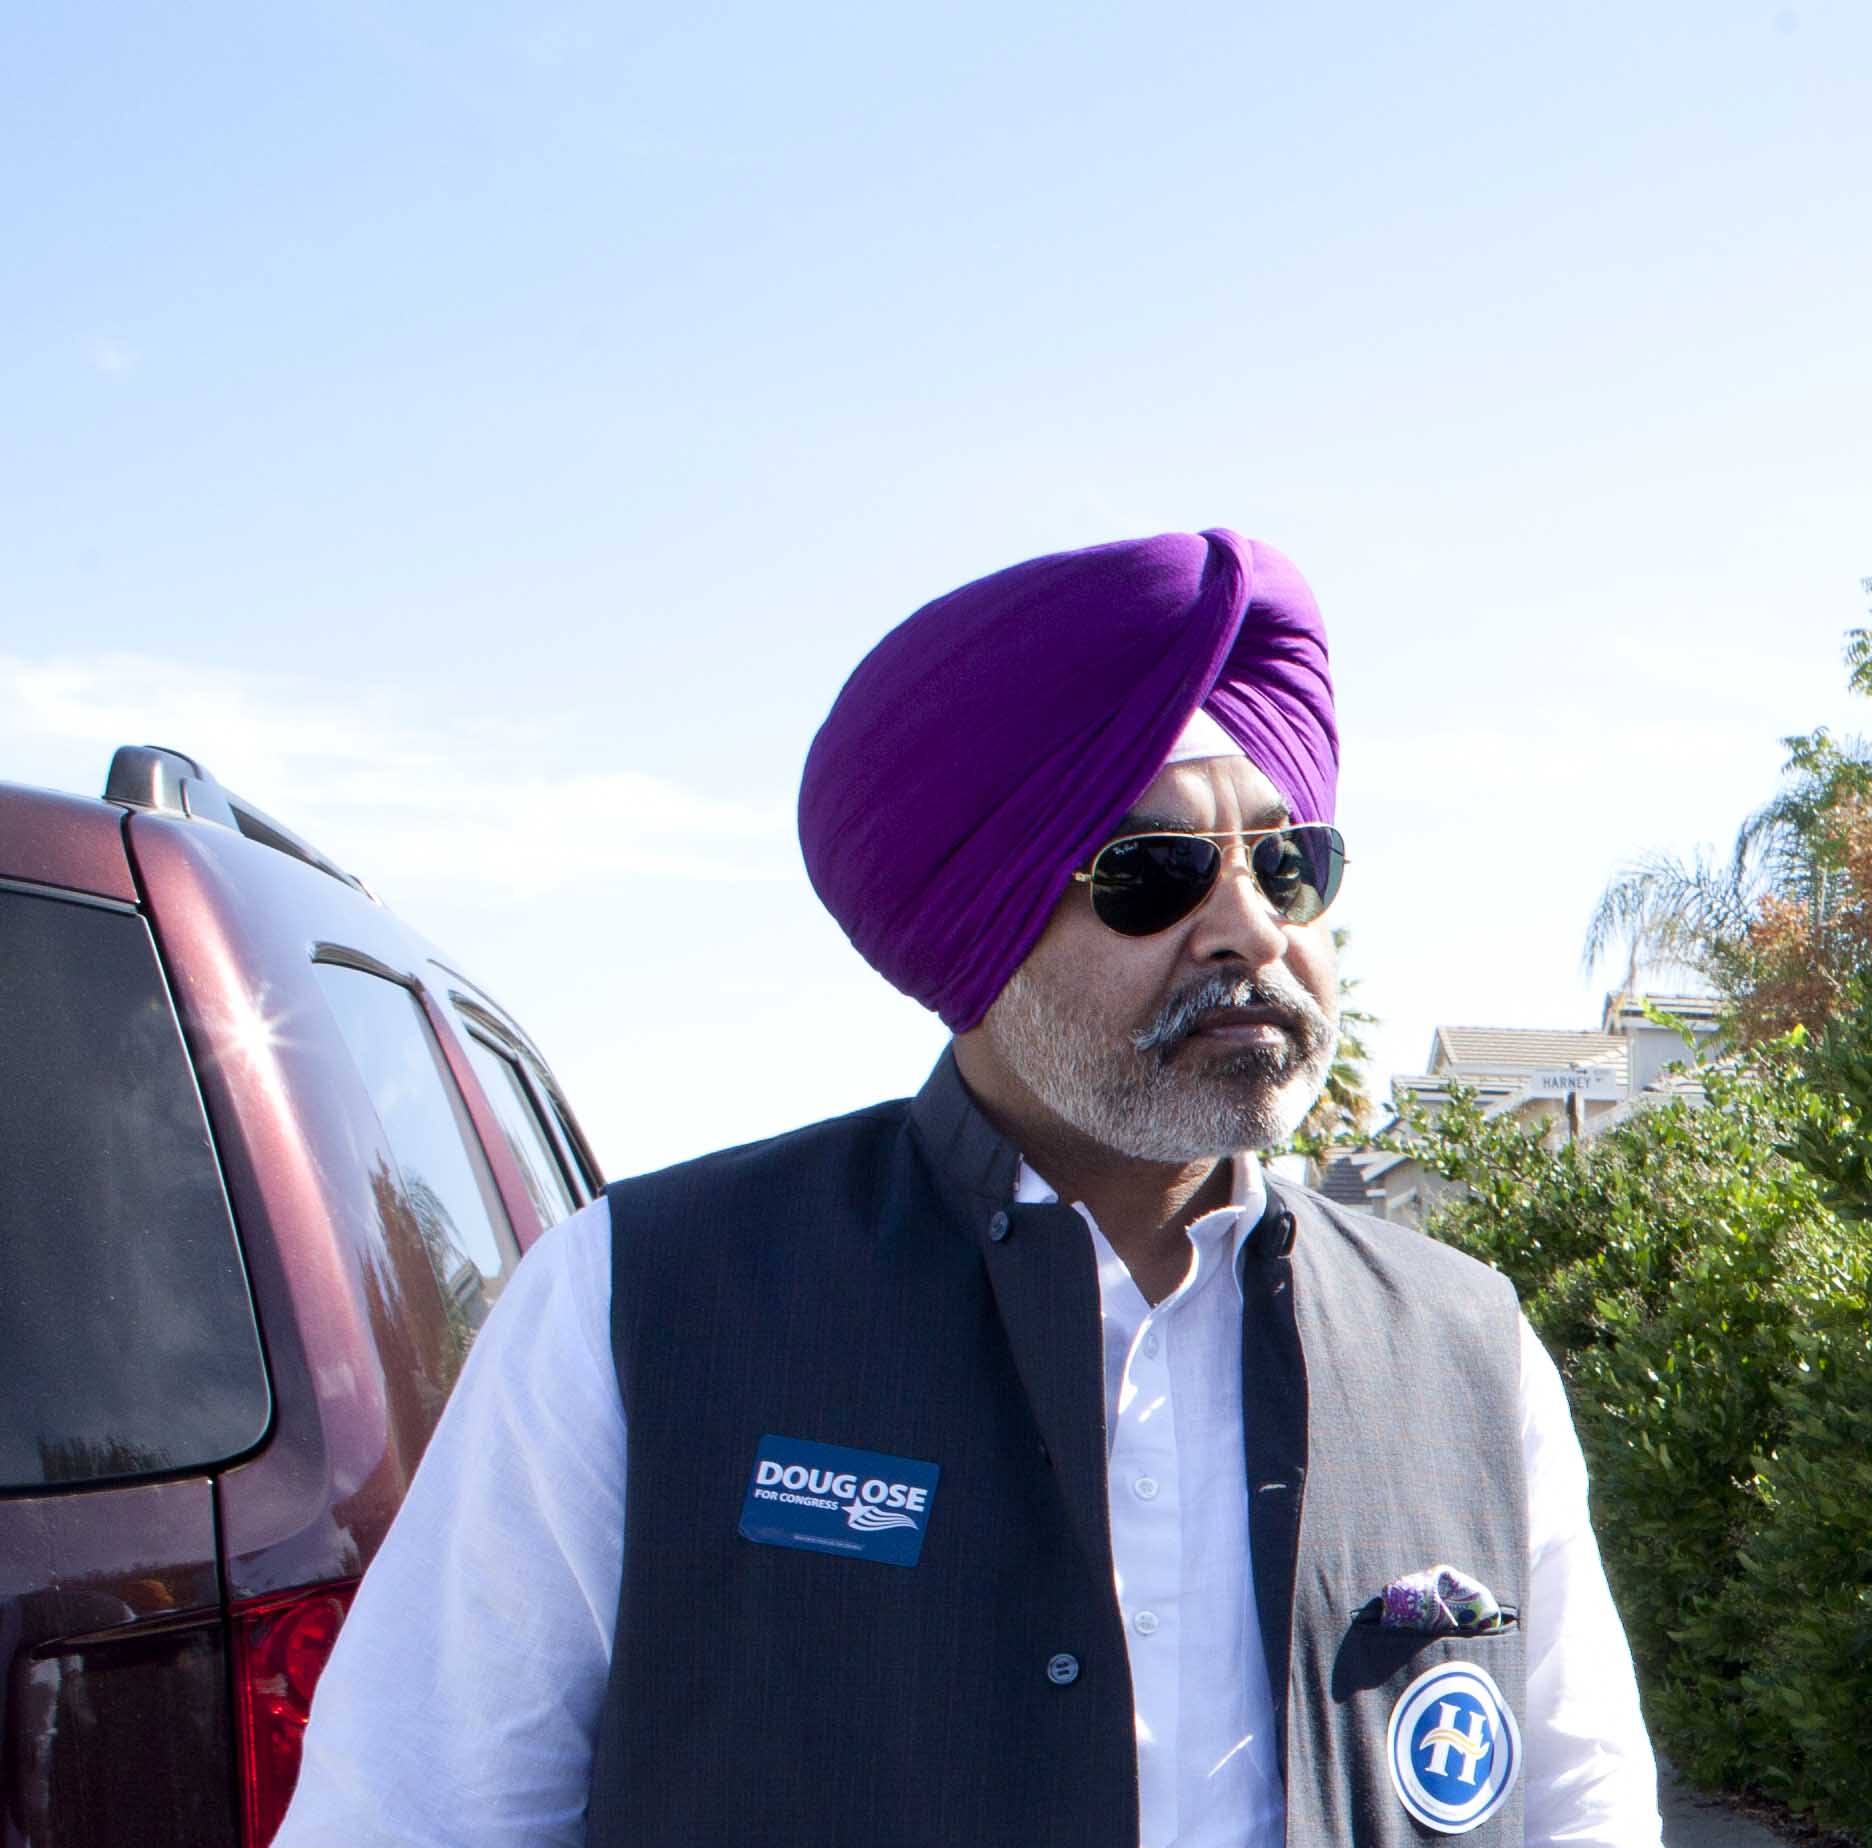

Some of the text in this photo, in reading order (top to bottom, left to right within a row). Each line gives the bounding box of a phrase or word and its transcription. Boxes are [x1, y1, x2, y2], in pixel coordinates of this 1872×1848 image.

[1543, 1076, 1592, 1089] HARNEY
[755, 1460, 928, 1512] DOUG OSE
[754, 1488, 840, 1511] FOR CONGRESS
